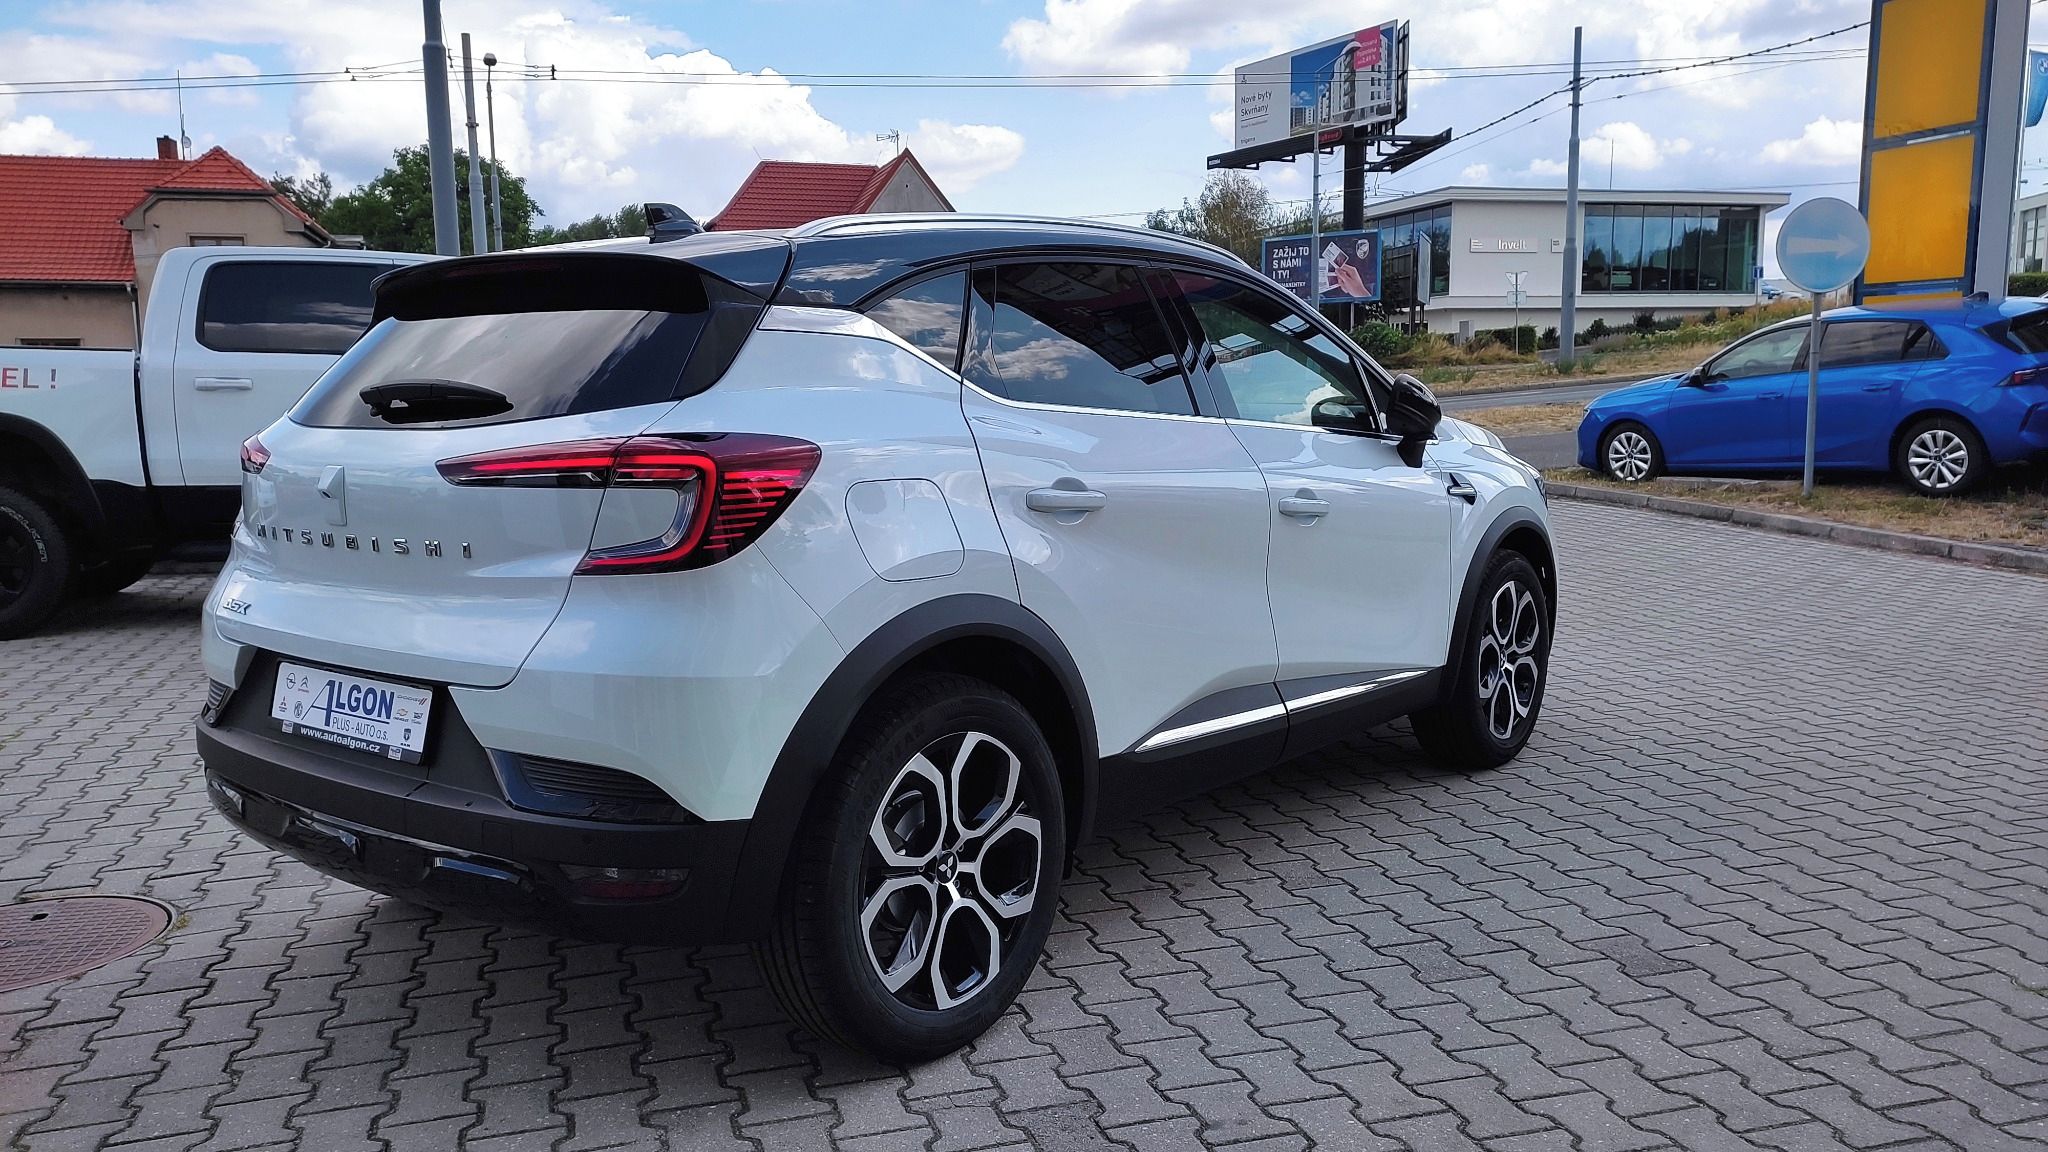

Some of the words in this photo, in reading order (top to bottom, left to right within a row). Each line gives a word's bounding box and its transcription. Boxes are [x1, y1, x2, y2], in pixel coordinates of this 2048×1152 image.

[1240, 92, 1256, 104] Nové
[1257, 90, 1272, 102] byty
[1240, 104, 1269, 117] Skvrňany
[1498, 239, 1527, 250] Invelt
[1273, 246, 1296, 258] ZAŽIJ
[1298, 247, 1309, 256] TO
[1273, 260, 1278, 268] S
[1280, 257, 1301, 268] NÁMI
[256, 523, 472, 559] MITSUBISHI
[300, 679, 395, 727] ALGON
[331, 716, 351, 732] PLUS
[355, 721, 376, 738] AUTO
[300, 726, 381, 753] www.autoalgon.cz
